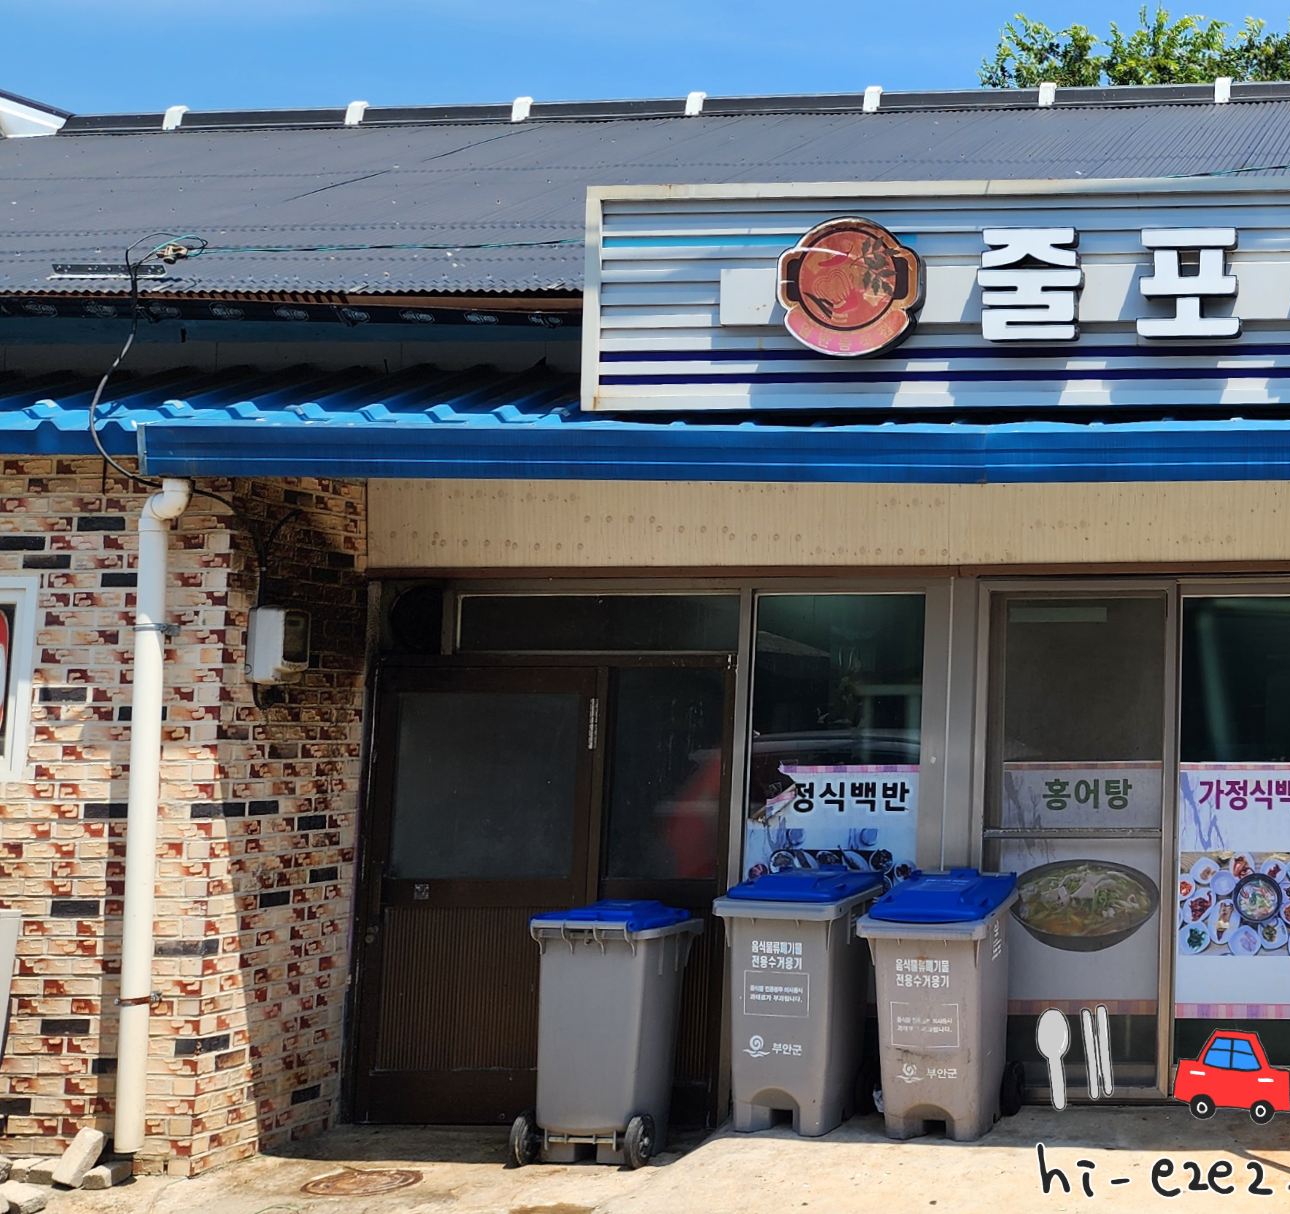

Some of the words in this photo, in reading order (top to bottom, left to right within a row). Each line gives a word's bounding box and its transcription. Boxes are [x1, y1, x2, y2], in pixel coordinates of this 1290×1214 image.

[793, 782, 910, 813] 정식백반
[1042, 778, 1133, 811] 홍어탕
[751, 940, 803, 955] 음식물류폐기물
[751, 955, 803, 970] 전용수거용기
[895, 958, 950, 973] 음식물류폐기물
[895, 973, 950, 988] 전용수거용기
[772, 1042, 803, 1056] 부안군
[926, 1068, 957, 1079] 부안군
